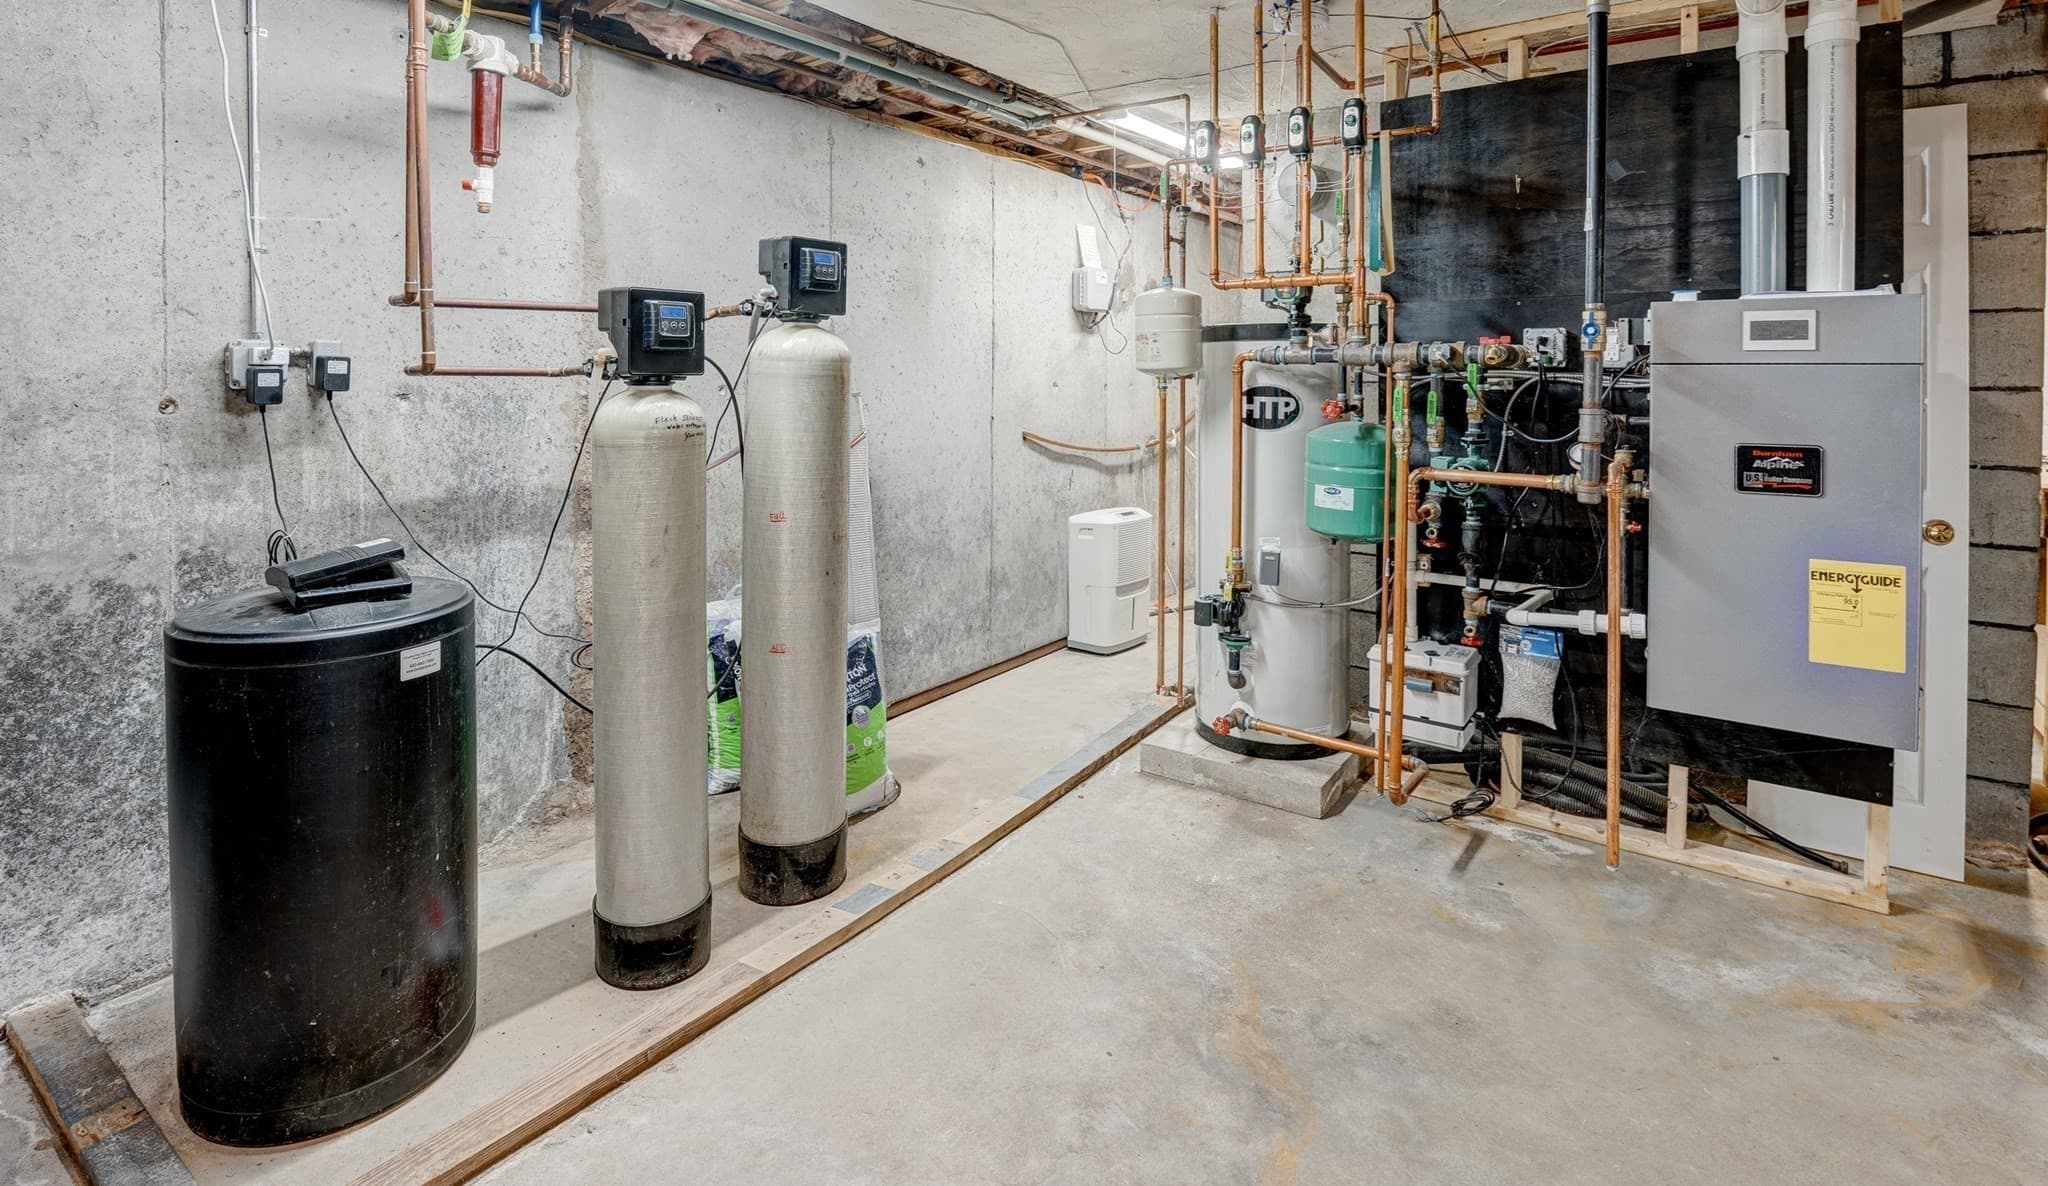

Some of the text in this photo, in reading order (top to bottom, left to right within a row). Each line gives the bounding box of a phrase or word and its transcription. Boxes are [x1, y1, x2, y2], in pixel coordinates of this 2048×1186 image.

[1242, 396, 1297, 420] HTP
[1752, 458, 1800, 470] Alpine
[1810, 570, 1902, 589] ENERGYGUIDE
[847, 663, 867, 682] TON
